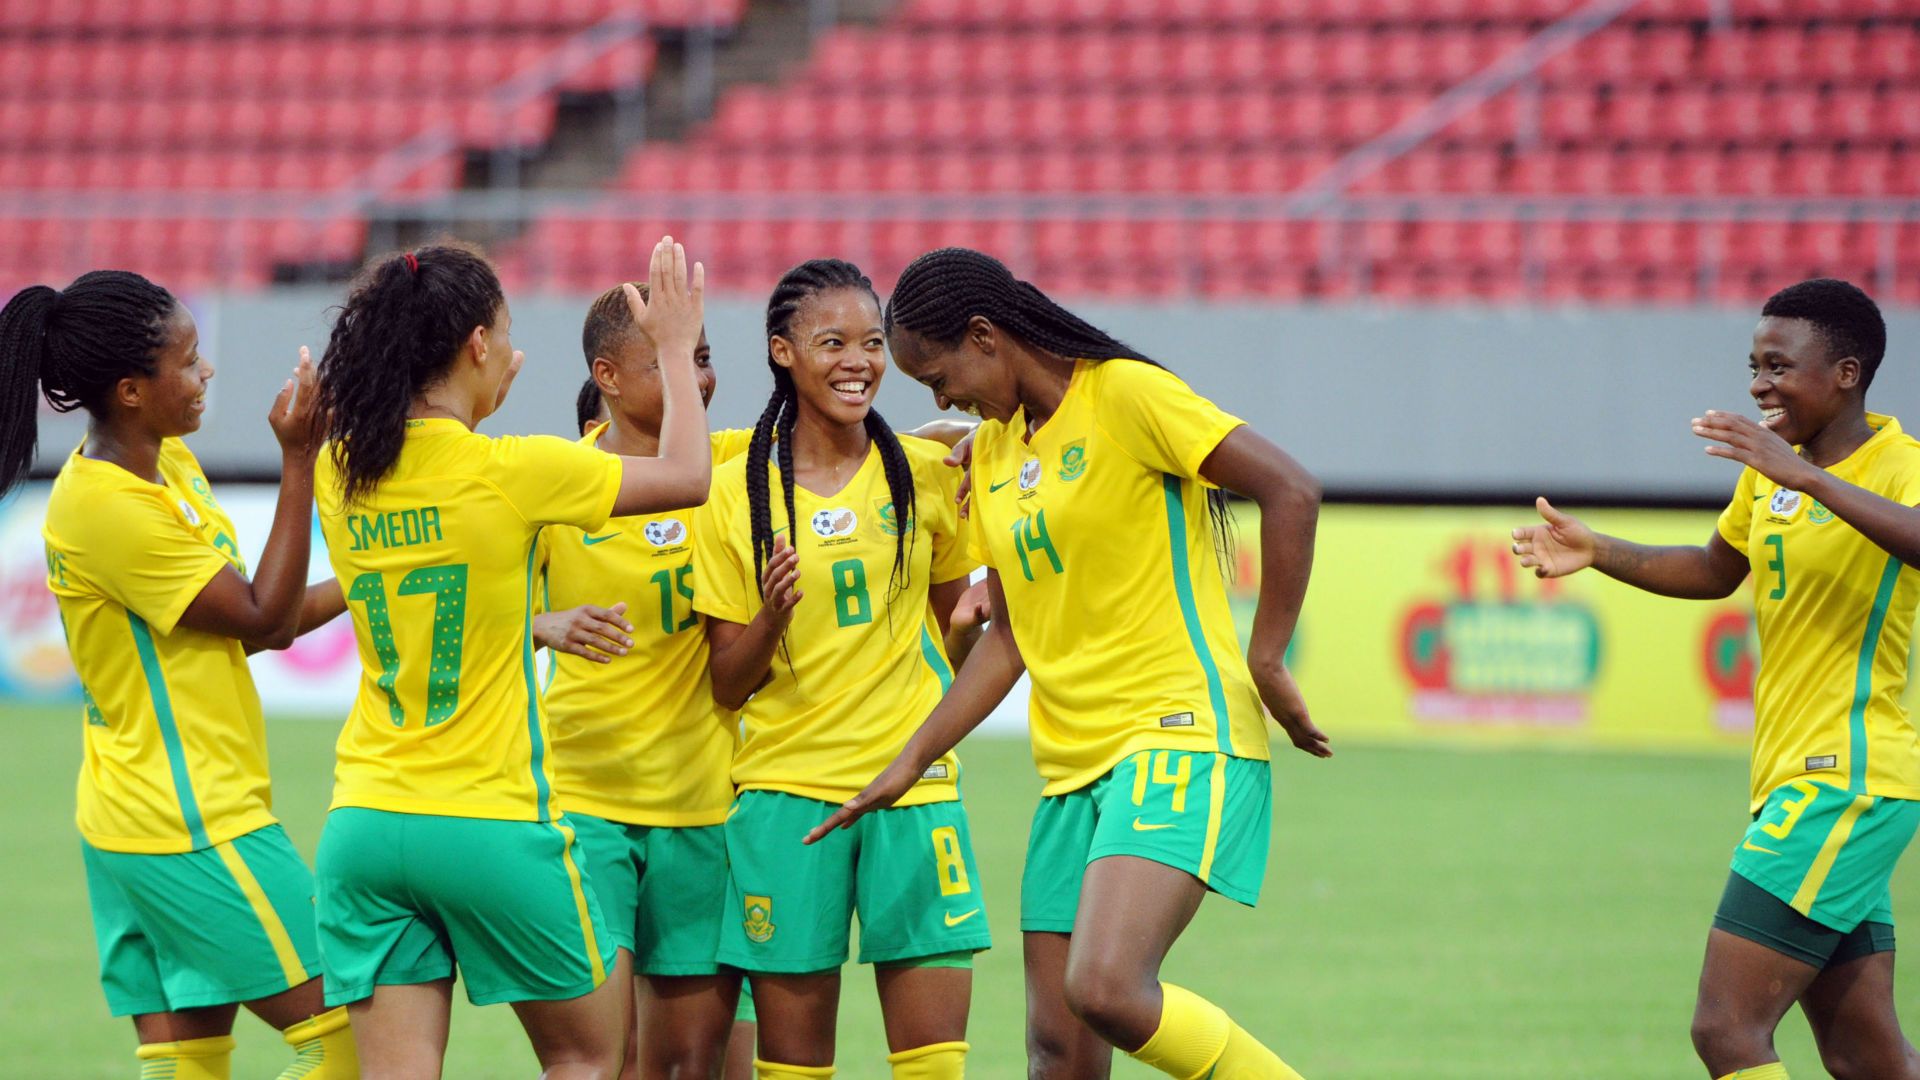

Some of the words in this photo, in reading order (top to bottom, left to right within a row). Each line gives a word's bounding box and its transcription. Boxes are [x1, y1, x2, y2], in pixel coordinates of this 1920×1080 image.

[348, 506, 443, 551] SMEDA
[1010, 508, 1064, 582] 14
[650, 563, 699, 634] 15
[831, 558, 873, 628] 8
[1764, 534, 1786, 600] 3
[348, 563, 468, 728] 17
[1129, 750, 1192, 813] 14
[1760, 780, 1820, 840] 3
[931, 825, 971, 897] 8
